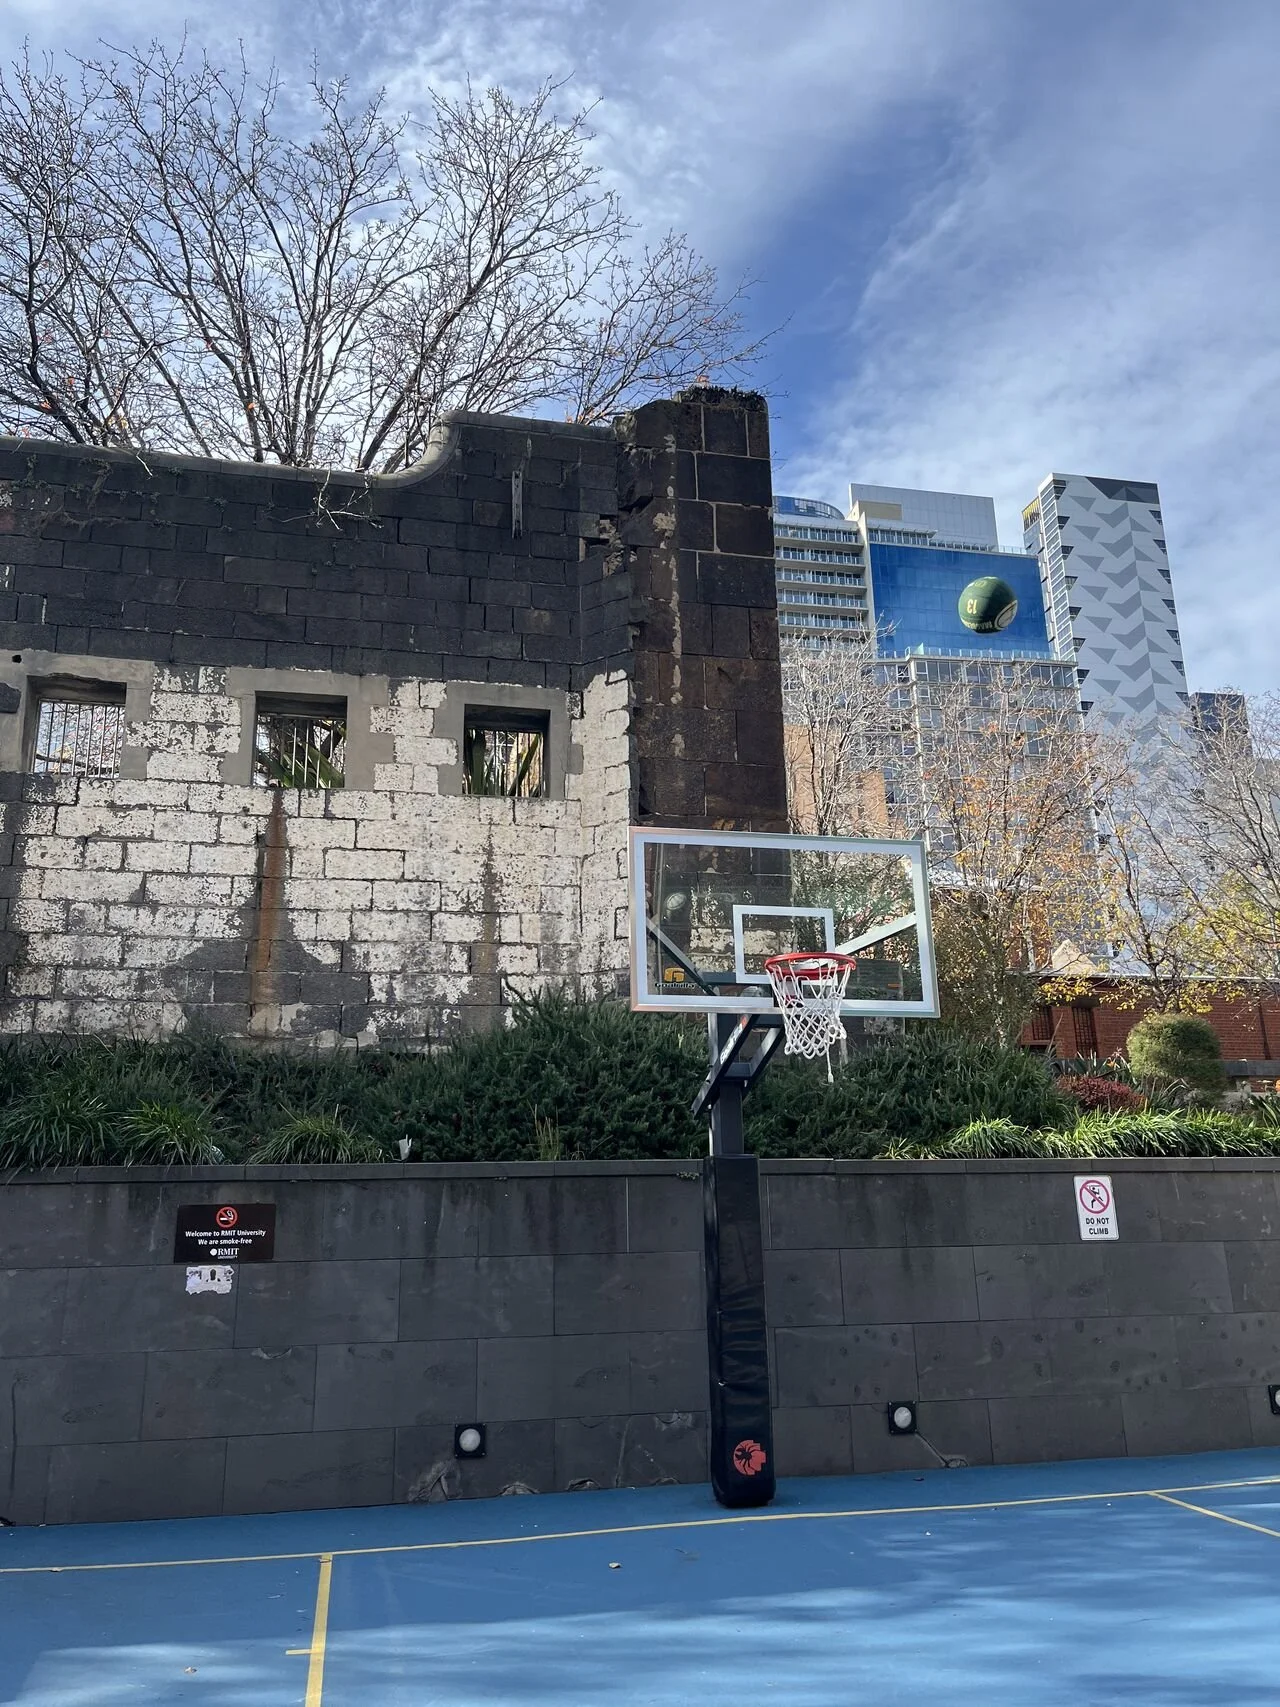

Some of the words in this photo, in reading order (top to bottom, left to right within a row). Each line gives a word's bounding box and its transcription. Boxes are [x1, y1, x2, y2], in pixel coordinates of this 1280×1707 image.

[966, 598, 978, 615] 13
[1085, 1217, 1095, 1225] DO
[1096, 1217, 1110, 1225] NOT
[237, 1229, 266, 1237] University
[1088, 1227, 1109, 1235] CLIMB
[219, 1237, 252, 1245] smoke-free
[217, 1247, 240, 1256] RMIT
